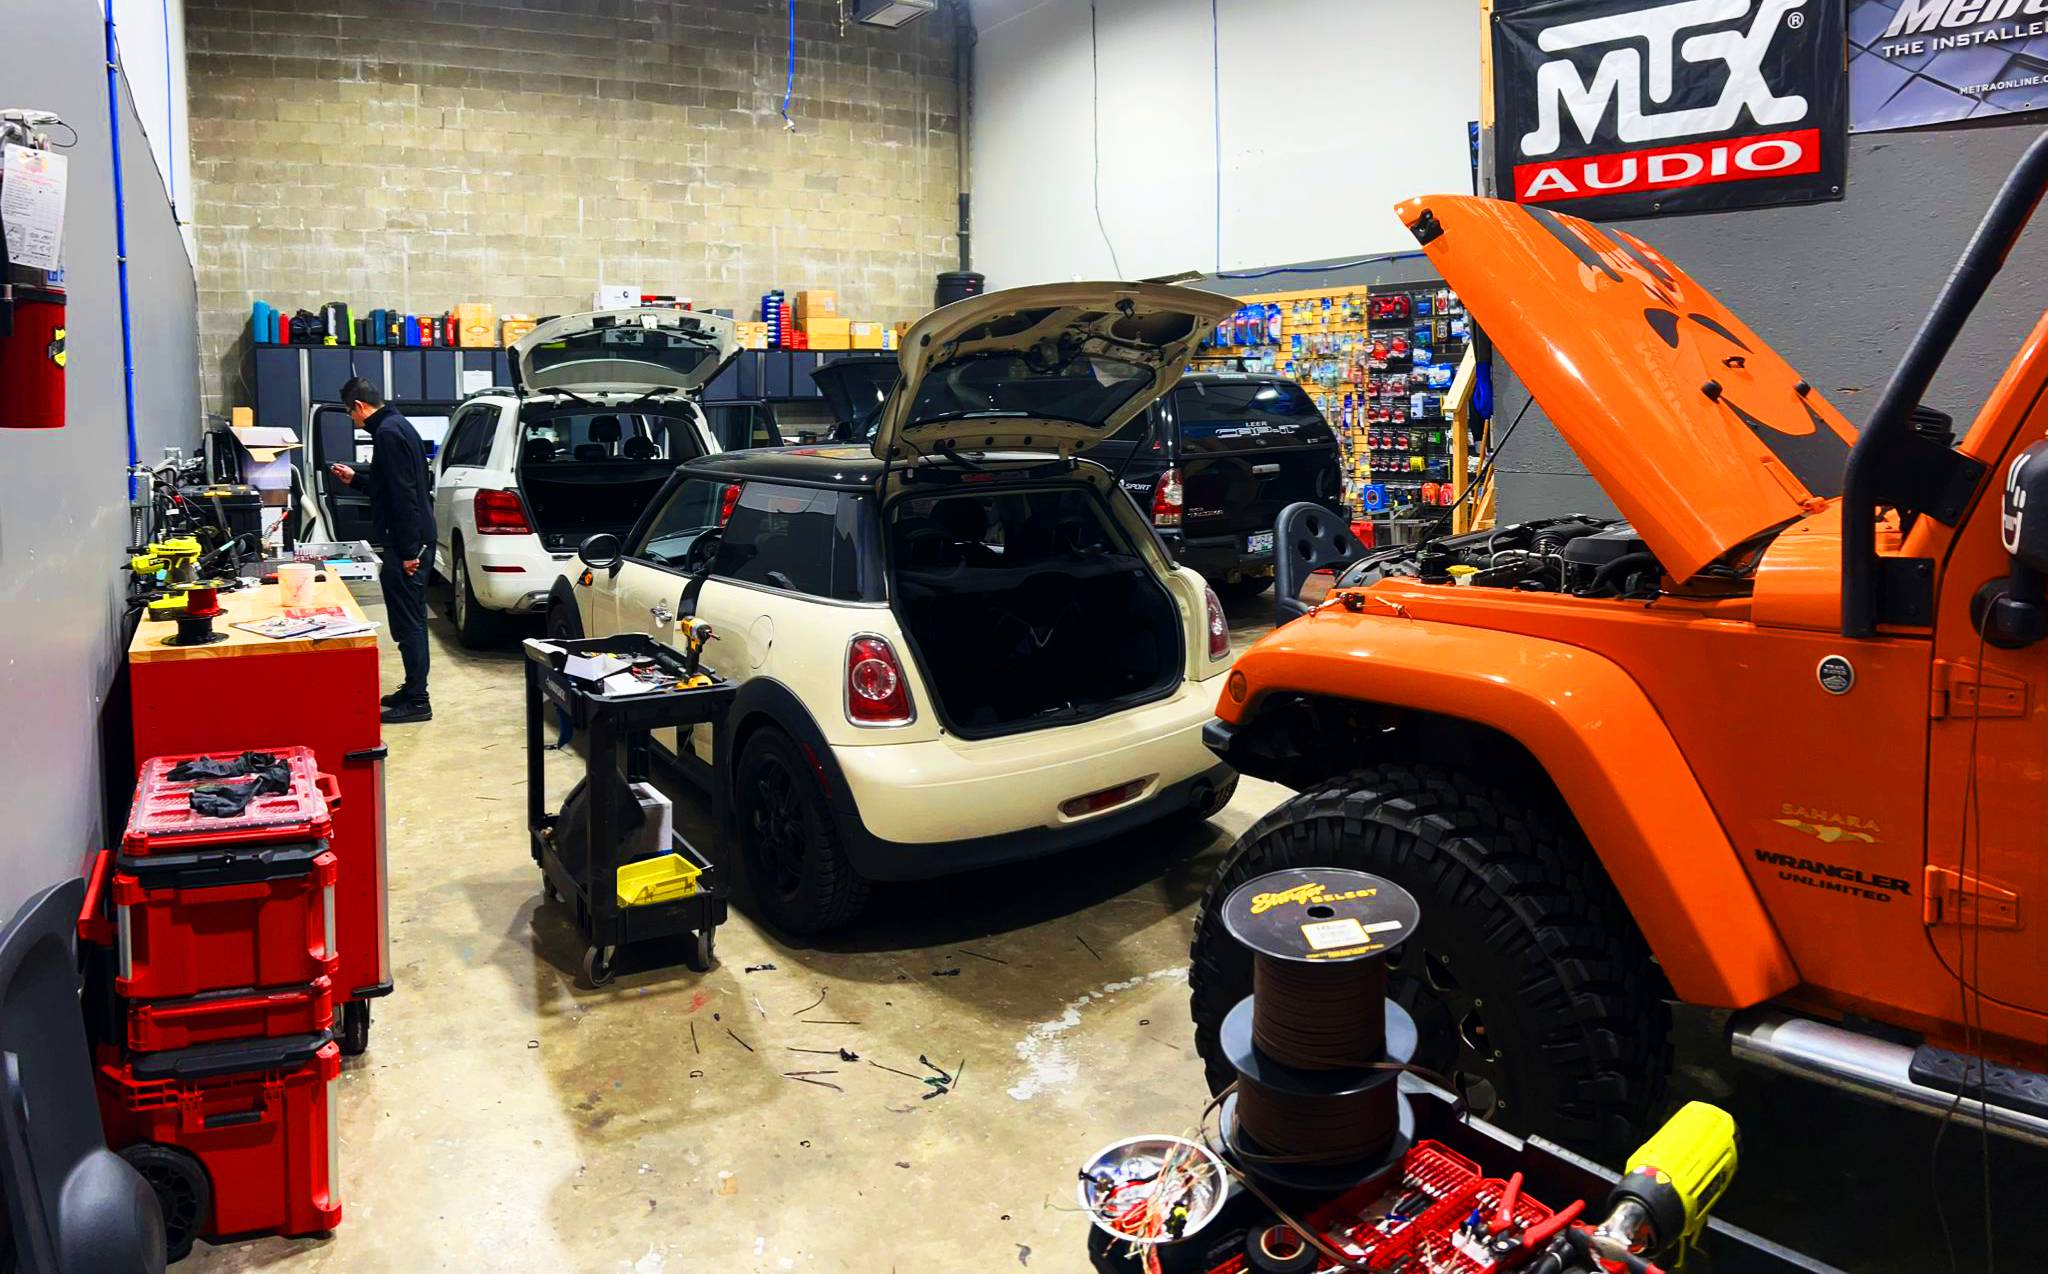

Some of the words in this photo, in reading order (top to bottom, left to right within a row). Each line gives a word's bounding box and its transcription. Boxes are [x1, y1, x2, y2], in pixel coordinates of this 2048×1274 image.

[1881, 40, 1924, 58] THE
[1932, 17, 2048, 50] INSTALLE
[1520, 0, 1809, 156] MTX
[1524, 140, 1803, 197] AUDIO
[1125, 483, 1151, 491] SPORT
[1782, 803, 1880, 832] SAHARA
[1755, 849, 1912, 895] WRANGLER
[1778, 871, 1891, 902] UNLIMITED
